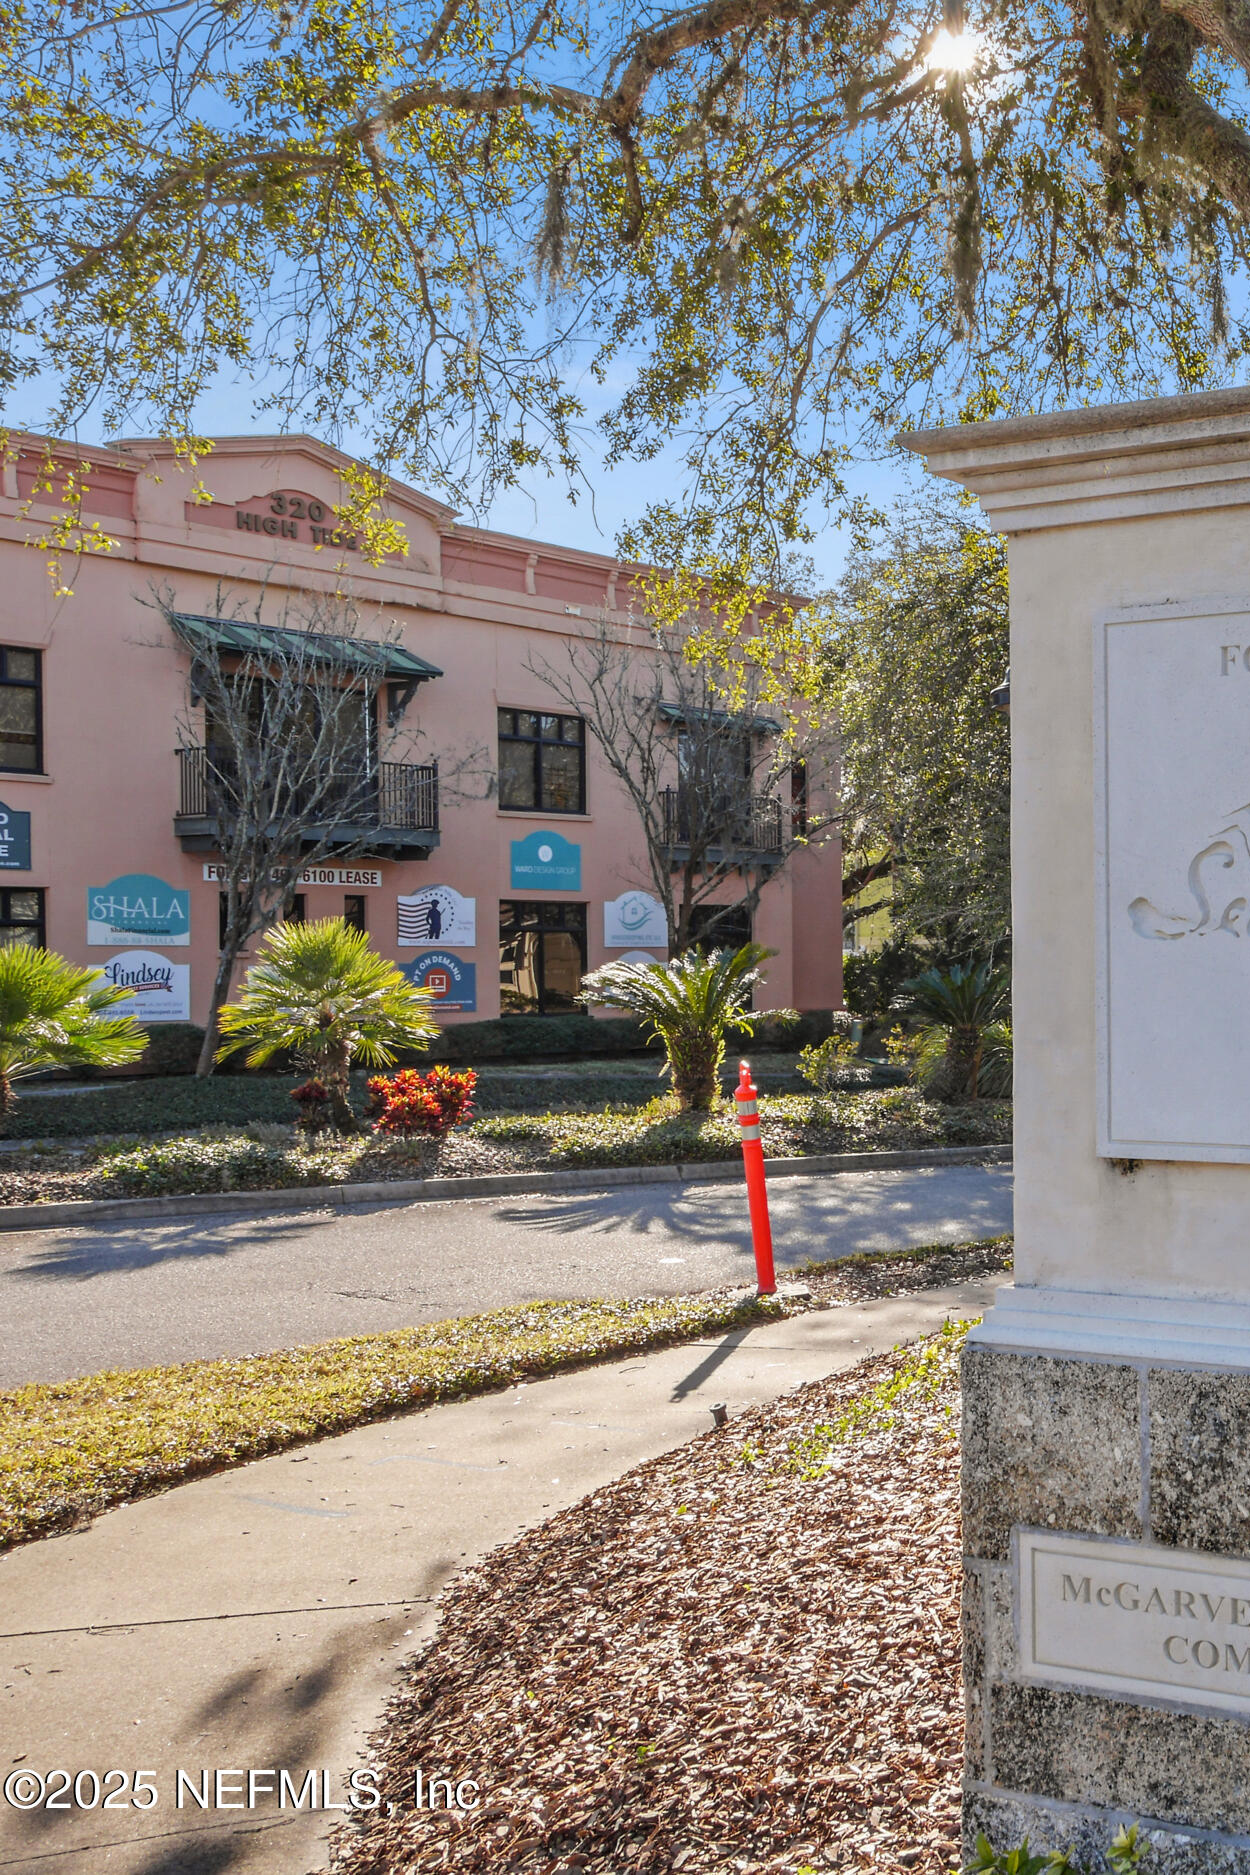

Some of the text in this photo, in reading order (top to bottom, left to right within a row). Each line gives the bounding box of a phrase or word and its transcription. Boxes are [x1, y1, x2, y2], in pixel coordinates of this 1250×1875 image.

[270, 492, 326, 523] 320
[236, 511, 298, 539] HIGH
[338, 870, 378, 885] LEASE
[91, 895, 185, 920] SHALA
[104, 962, 174, 988] Lindsey
[419, 957, 432, 970] ON
[431, 955, 462, 982] DEMAND
